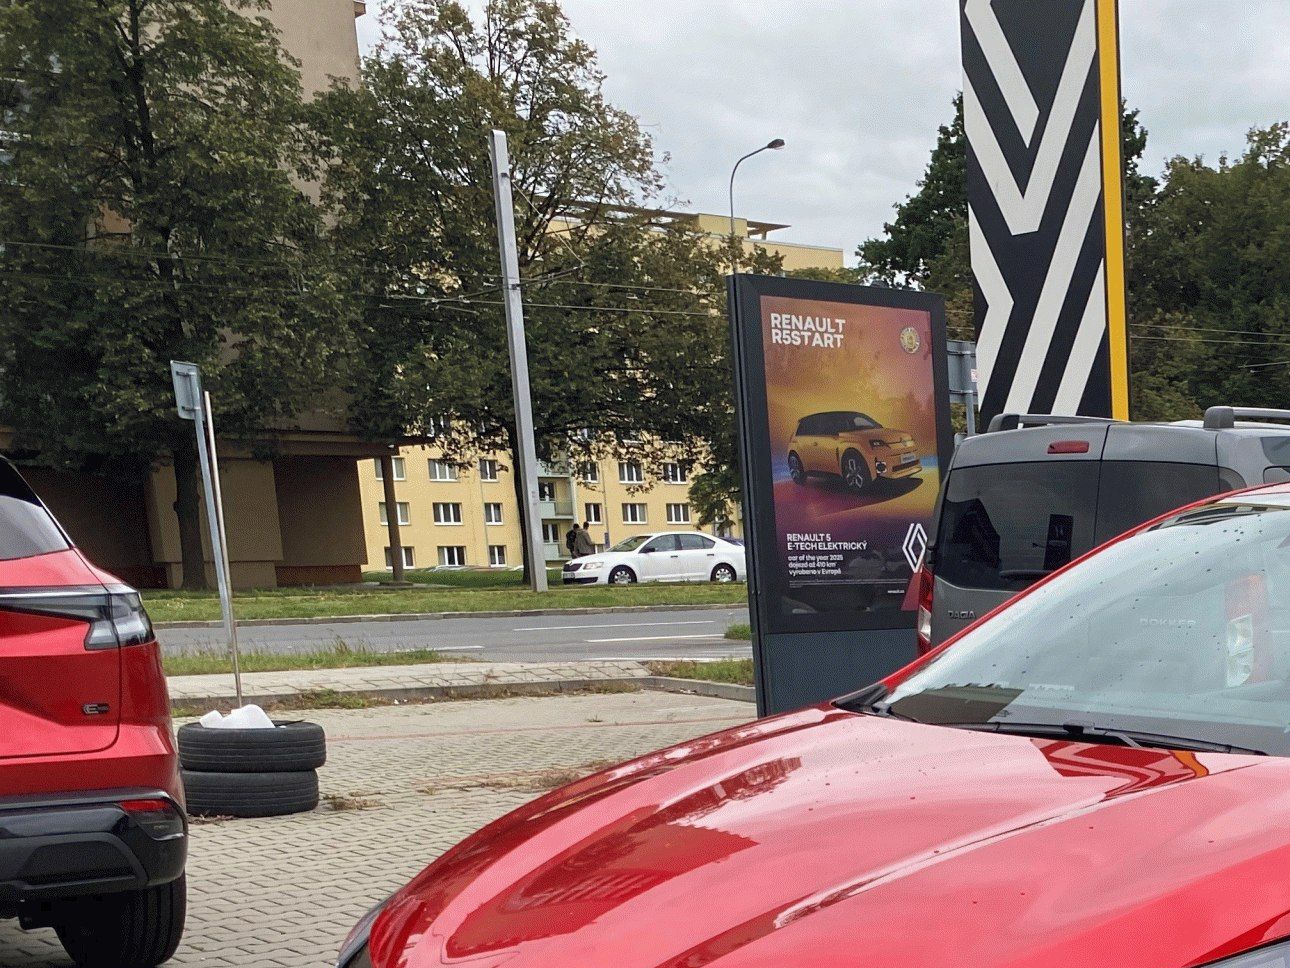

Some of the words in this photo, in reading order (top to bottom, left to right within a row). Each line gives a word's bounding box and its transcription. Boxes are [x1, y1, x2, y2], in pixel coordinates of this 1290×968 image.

[770, 313, 846, 333] RENAULT
[771, 328, 844, 348] R5START
[786, 533, 826, 542] RENAULT
[826, 533, 832, 541] 5
[787, 542, 819, 551] E-TECH
[818, 540, 868, 550] ELEKTRICKÝ
[947, 610, 976, 620] DACIA
